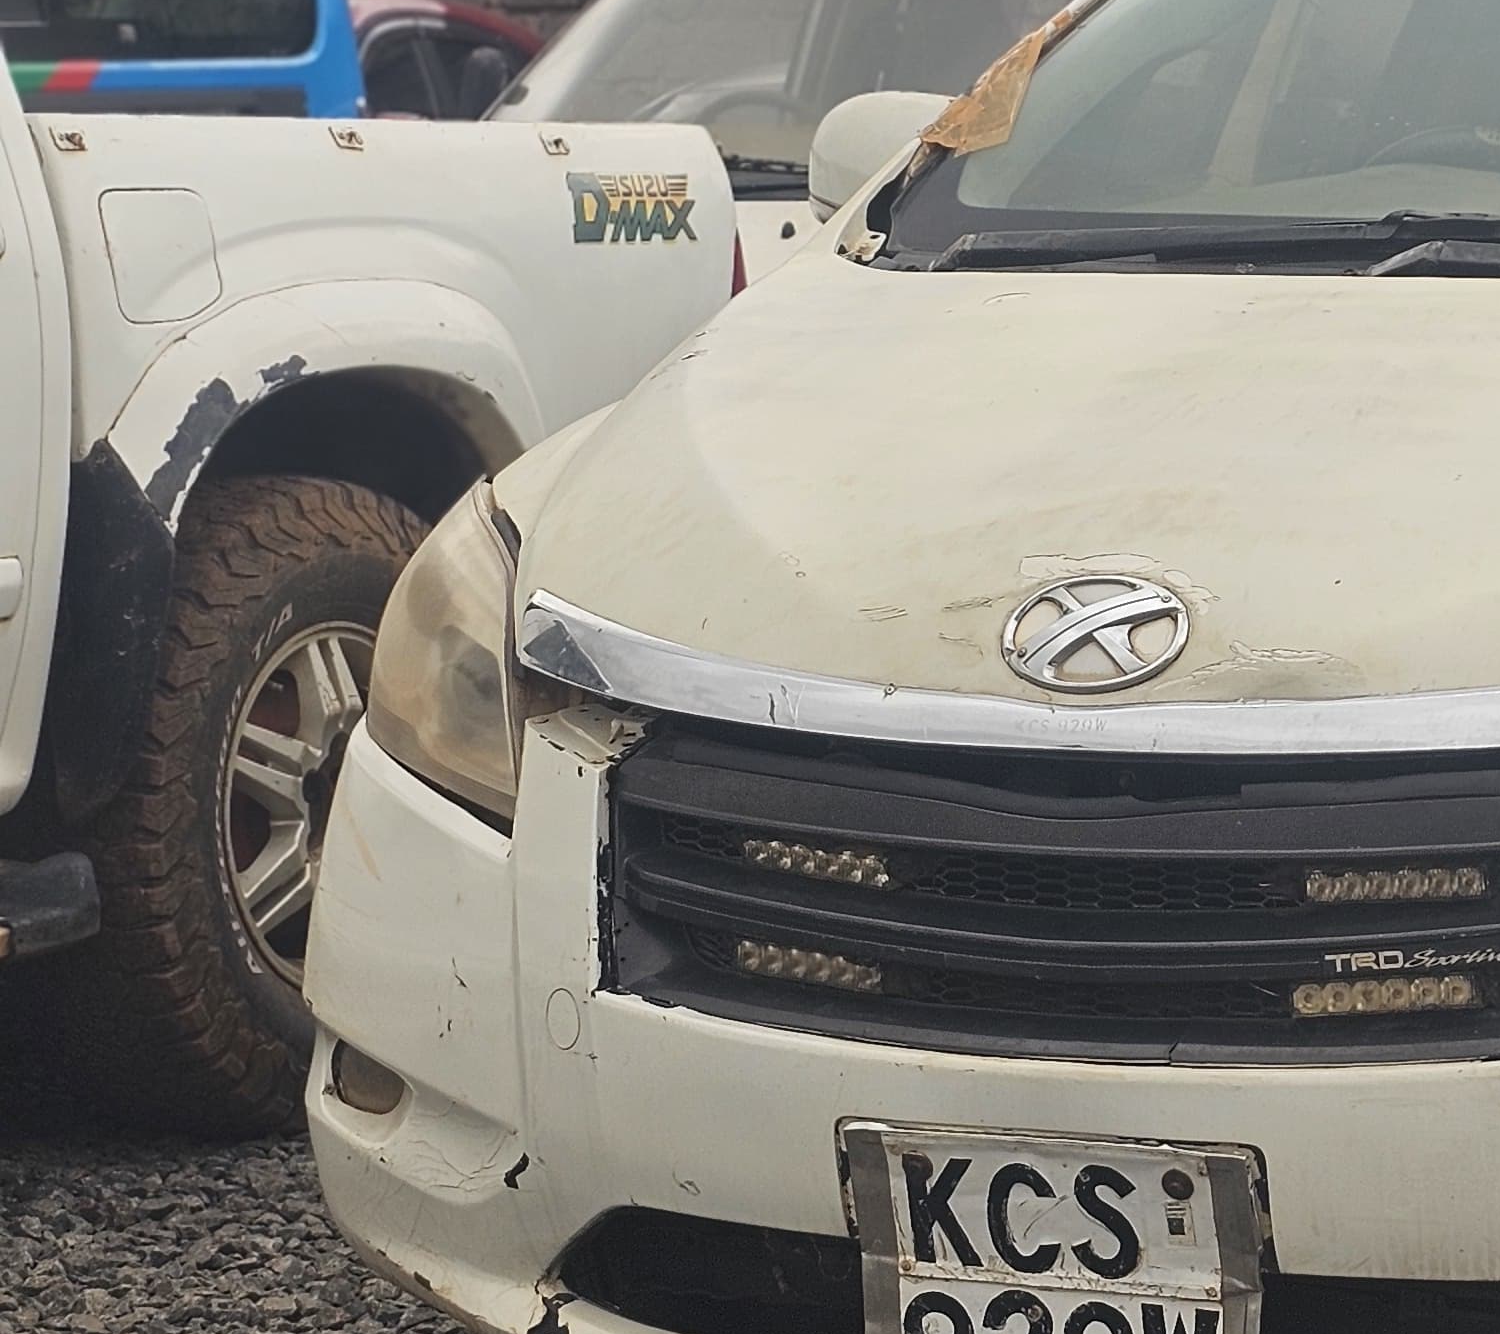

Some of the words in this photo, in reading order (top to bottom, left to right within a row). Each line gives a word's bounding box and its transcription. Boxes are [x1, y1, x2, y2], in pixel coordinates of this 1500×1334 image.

[612, 173, 669, 197] ISUZU
[1015, 719, 1050, 732] KCS
[1324, 950, 1404, 972] TRD
[902, 1153, 1140, 1279] KCS
